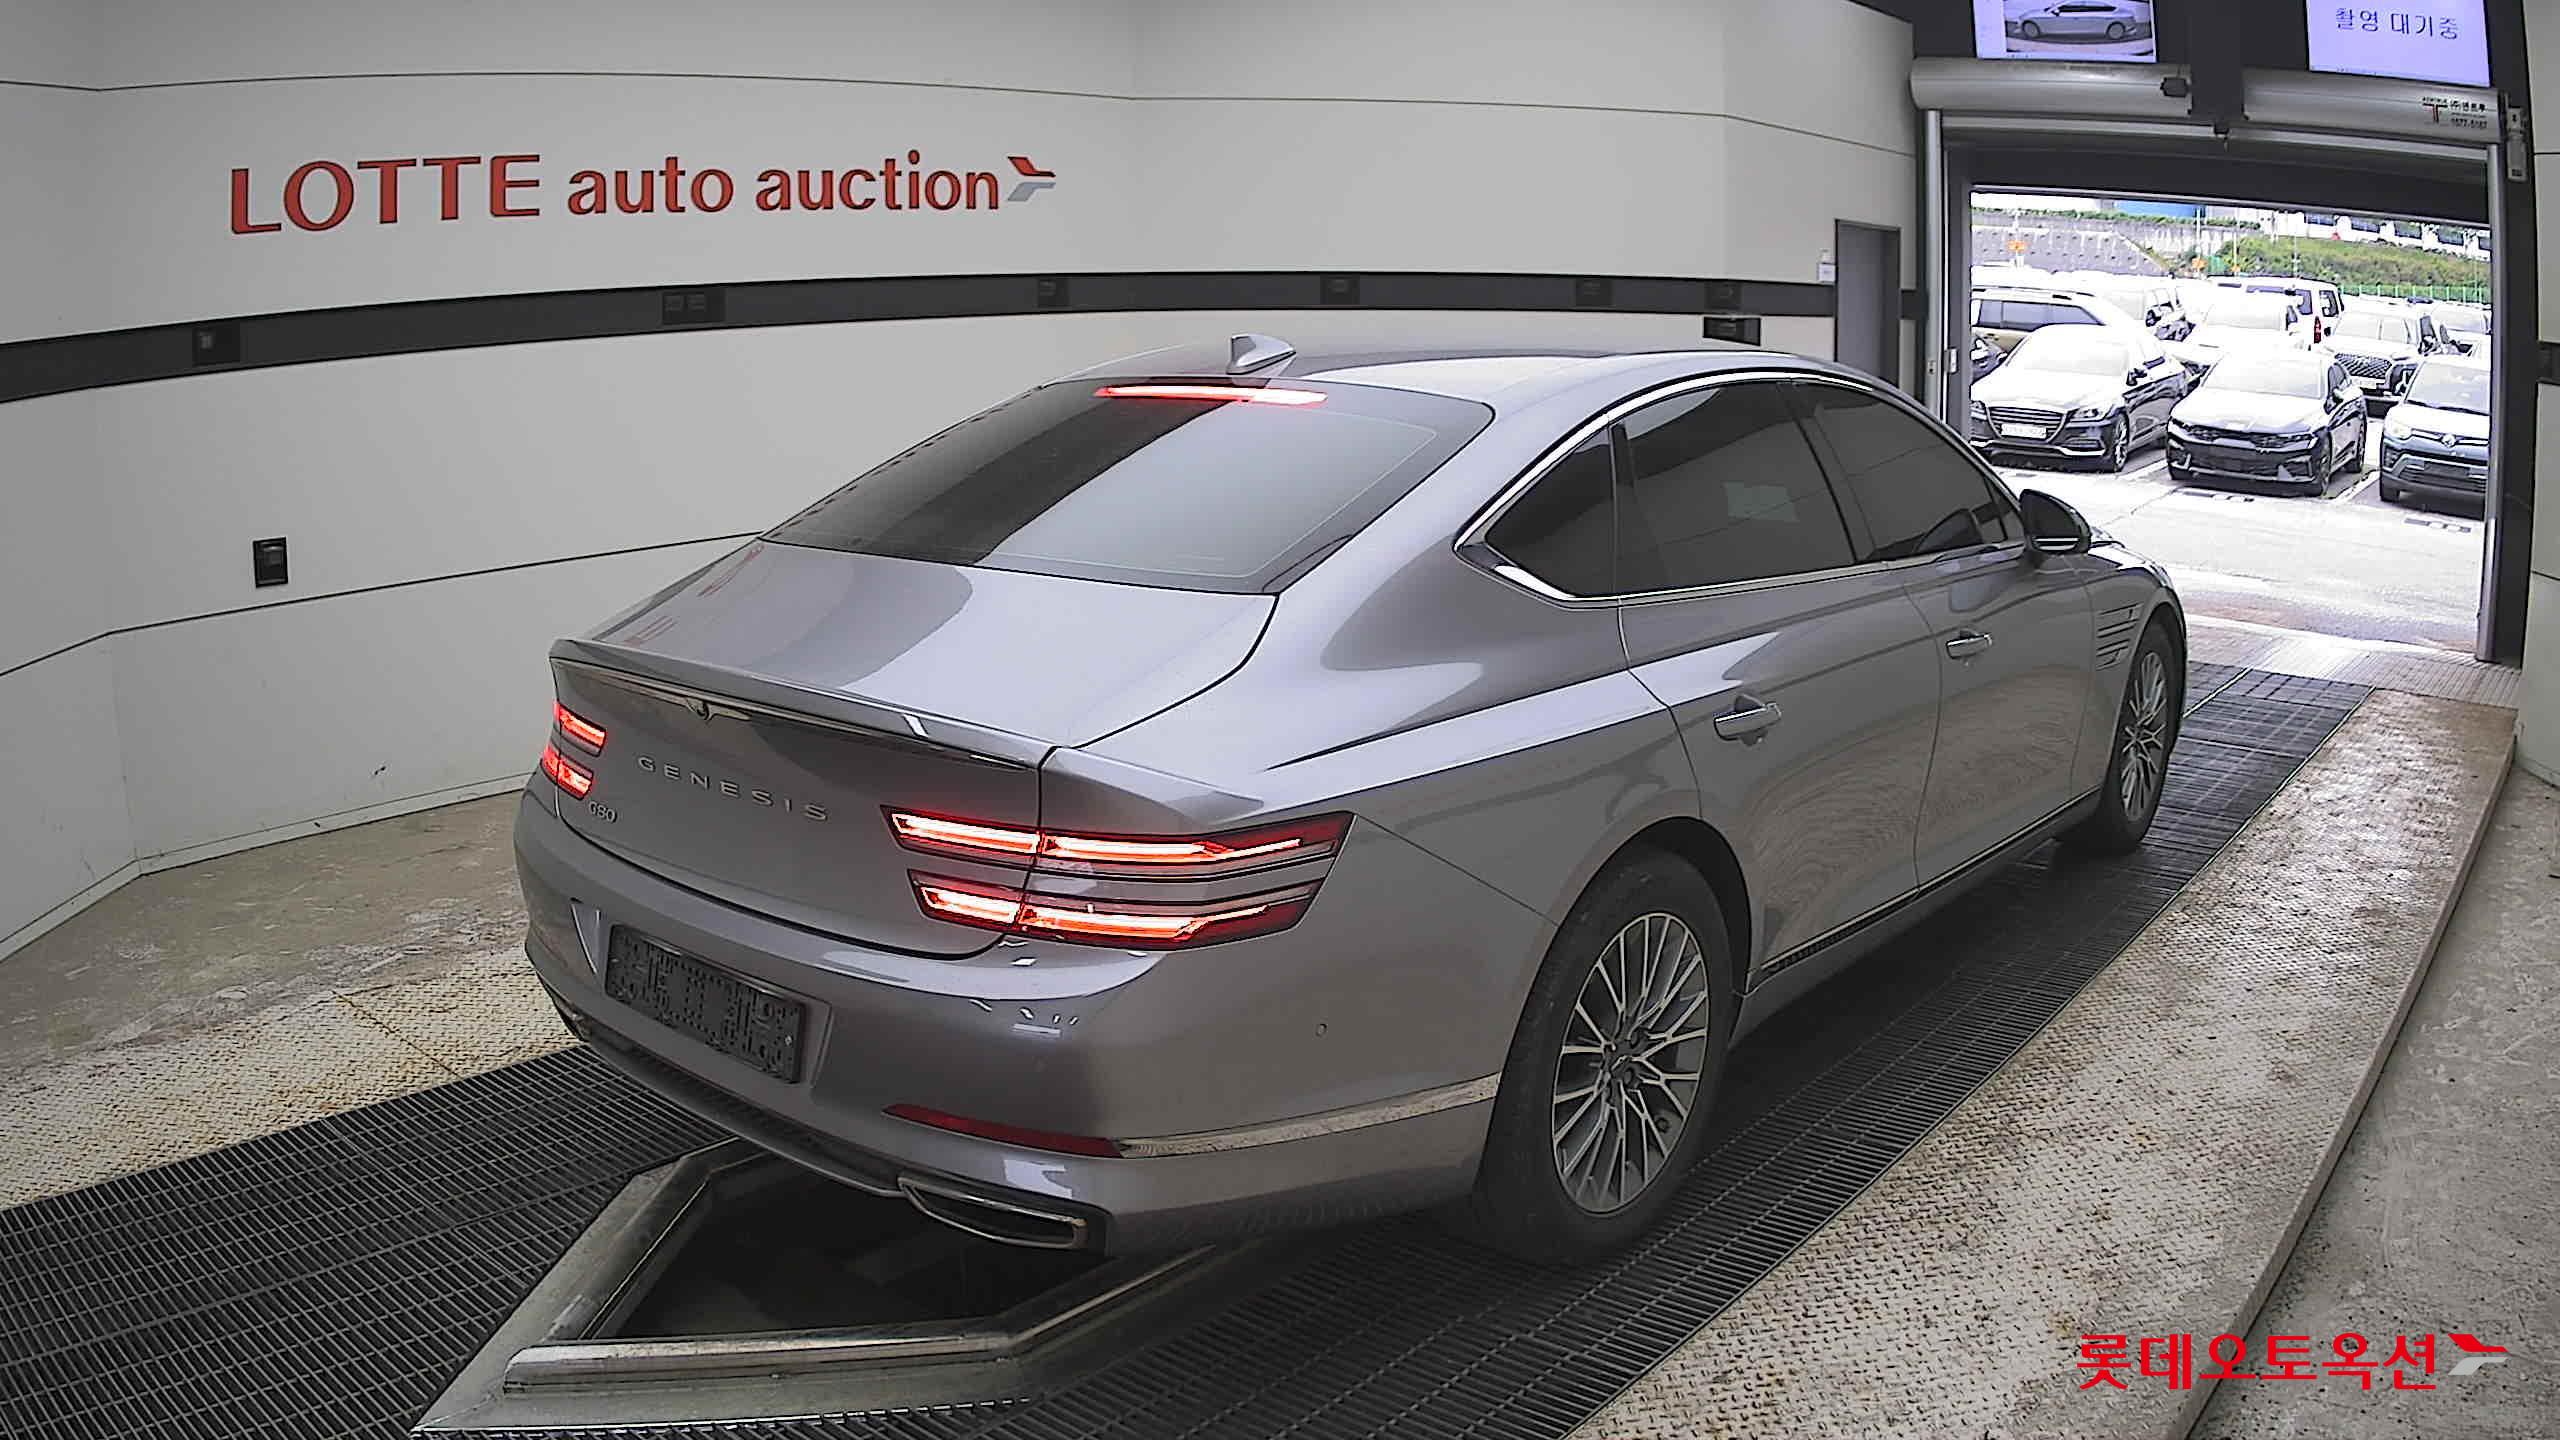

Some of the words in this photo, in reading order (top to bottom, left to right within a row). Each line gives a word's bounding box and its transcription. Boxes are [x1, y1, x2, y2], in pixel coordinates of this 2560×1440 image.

[2335, 7, 2379, 33] 촬영
[2390, 12, 2458, 40] 대기중
[230, 154, 540, 235] LOTTE
[567, 155, 735, 214] auto
[755, 149, 1000, 211] auction
[588, 801, 617, 823] G80
[636, 755, 829, 822] GENESIS
